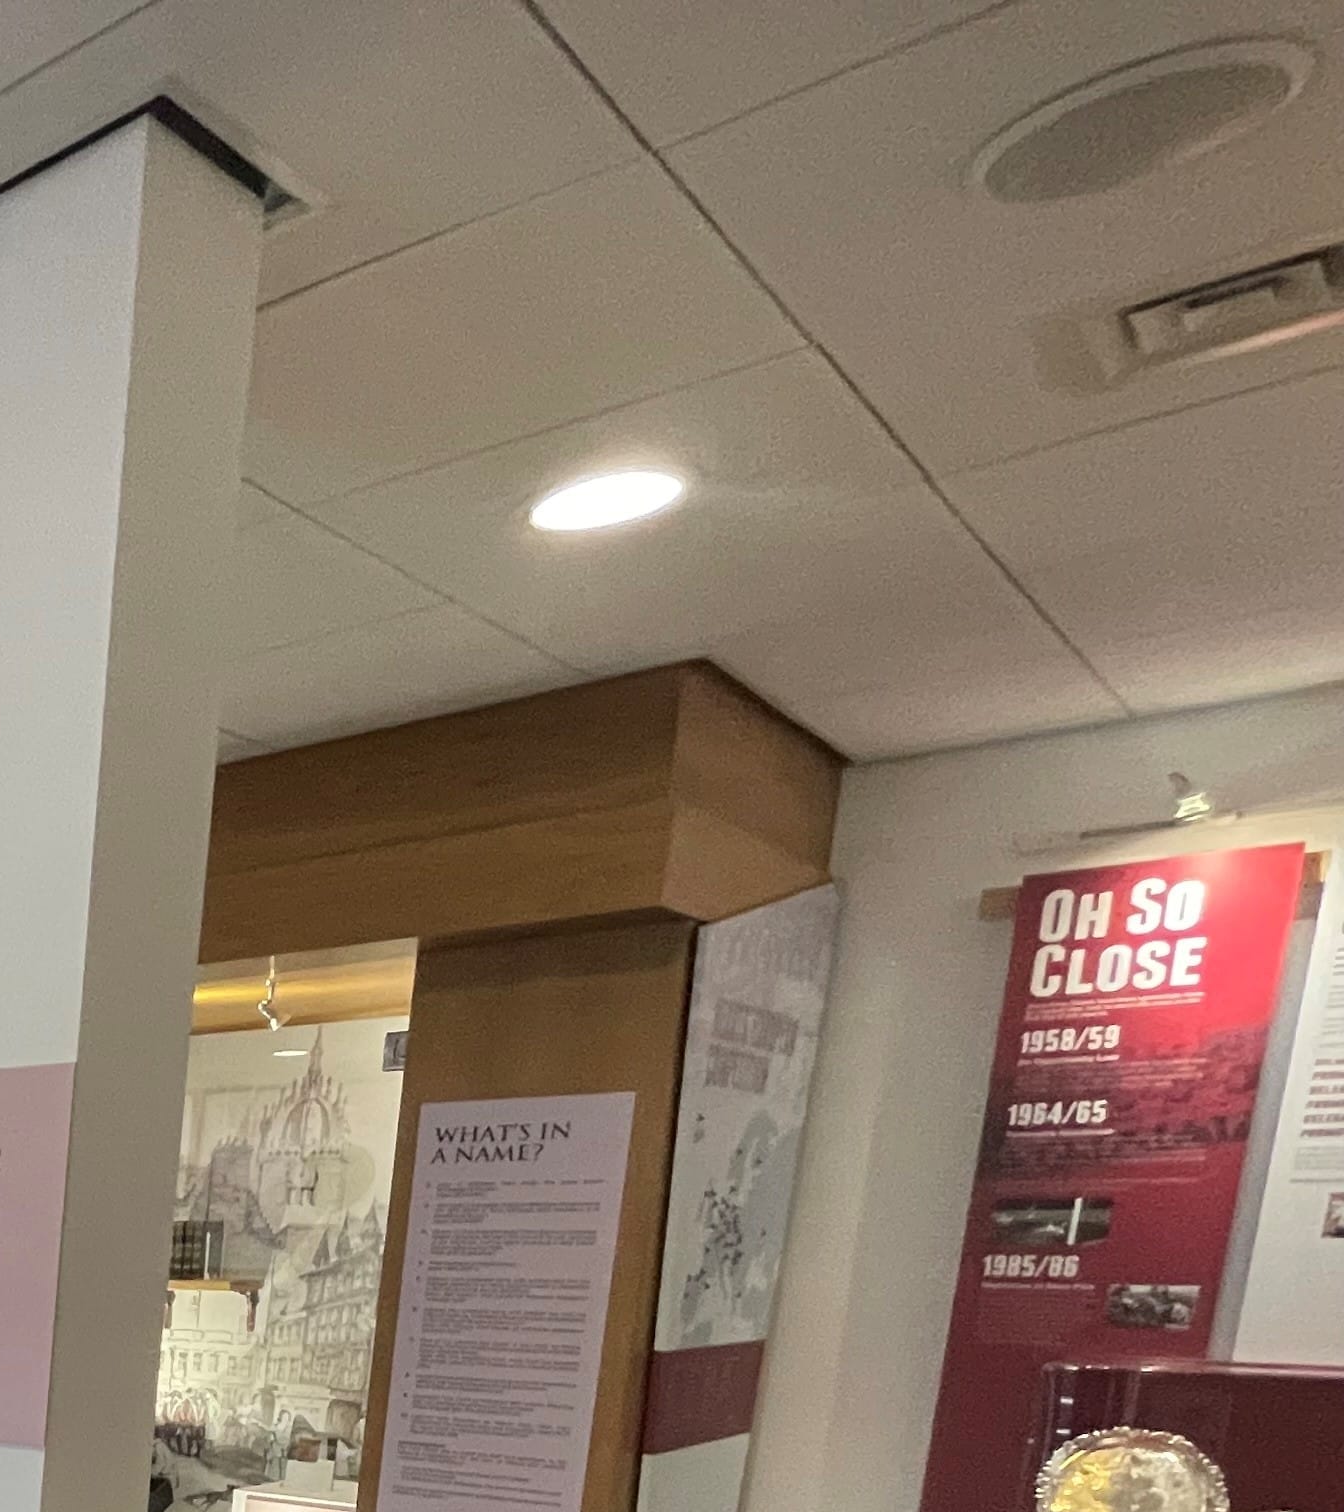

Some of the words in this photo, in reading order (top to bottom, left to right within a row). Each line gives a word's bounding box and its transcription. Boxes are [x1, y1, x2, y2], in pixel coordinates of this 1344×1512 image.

[1039, 889, 1113, 941] OH
[1126, 877, 1206, 936] SO
[1029, 936, 1208, 998] CLOSE
[1019, 1024, 1122, 1054] 1958/59
[1007, 1099, 1109, 1127] 1964/65
[434, 1121, 532, 1144] WHAT'S
[540, 1120, 572, 1141] IN
[430, 1146, 447, 1165] A
[454, 1143, 545, 1165] NAME?
[982, 1253, 1081, 1279] 1985/86
